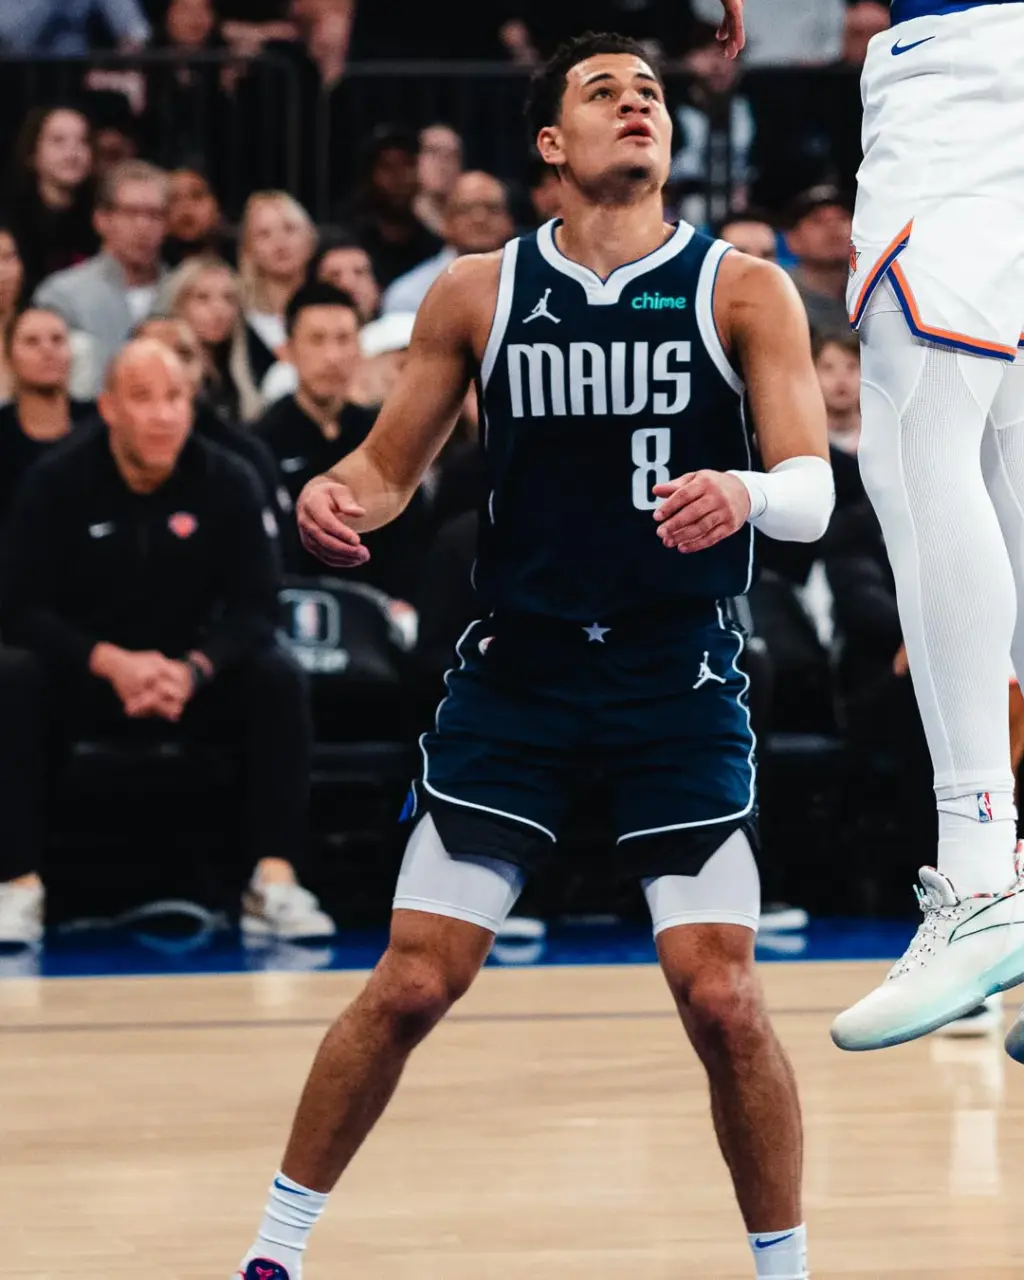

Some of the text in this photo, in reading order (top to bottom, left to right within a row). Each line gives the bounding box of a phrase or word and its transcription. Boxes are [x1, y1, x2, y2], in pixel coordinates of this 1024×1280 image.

[631, 292, 686, 310] chime
[507, 340, 692, 418] MAVS
[631, 427, 671, 511] 8
